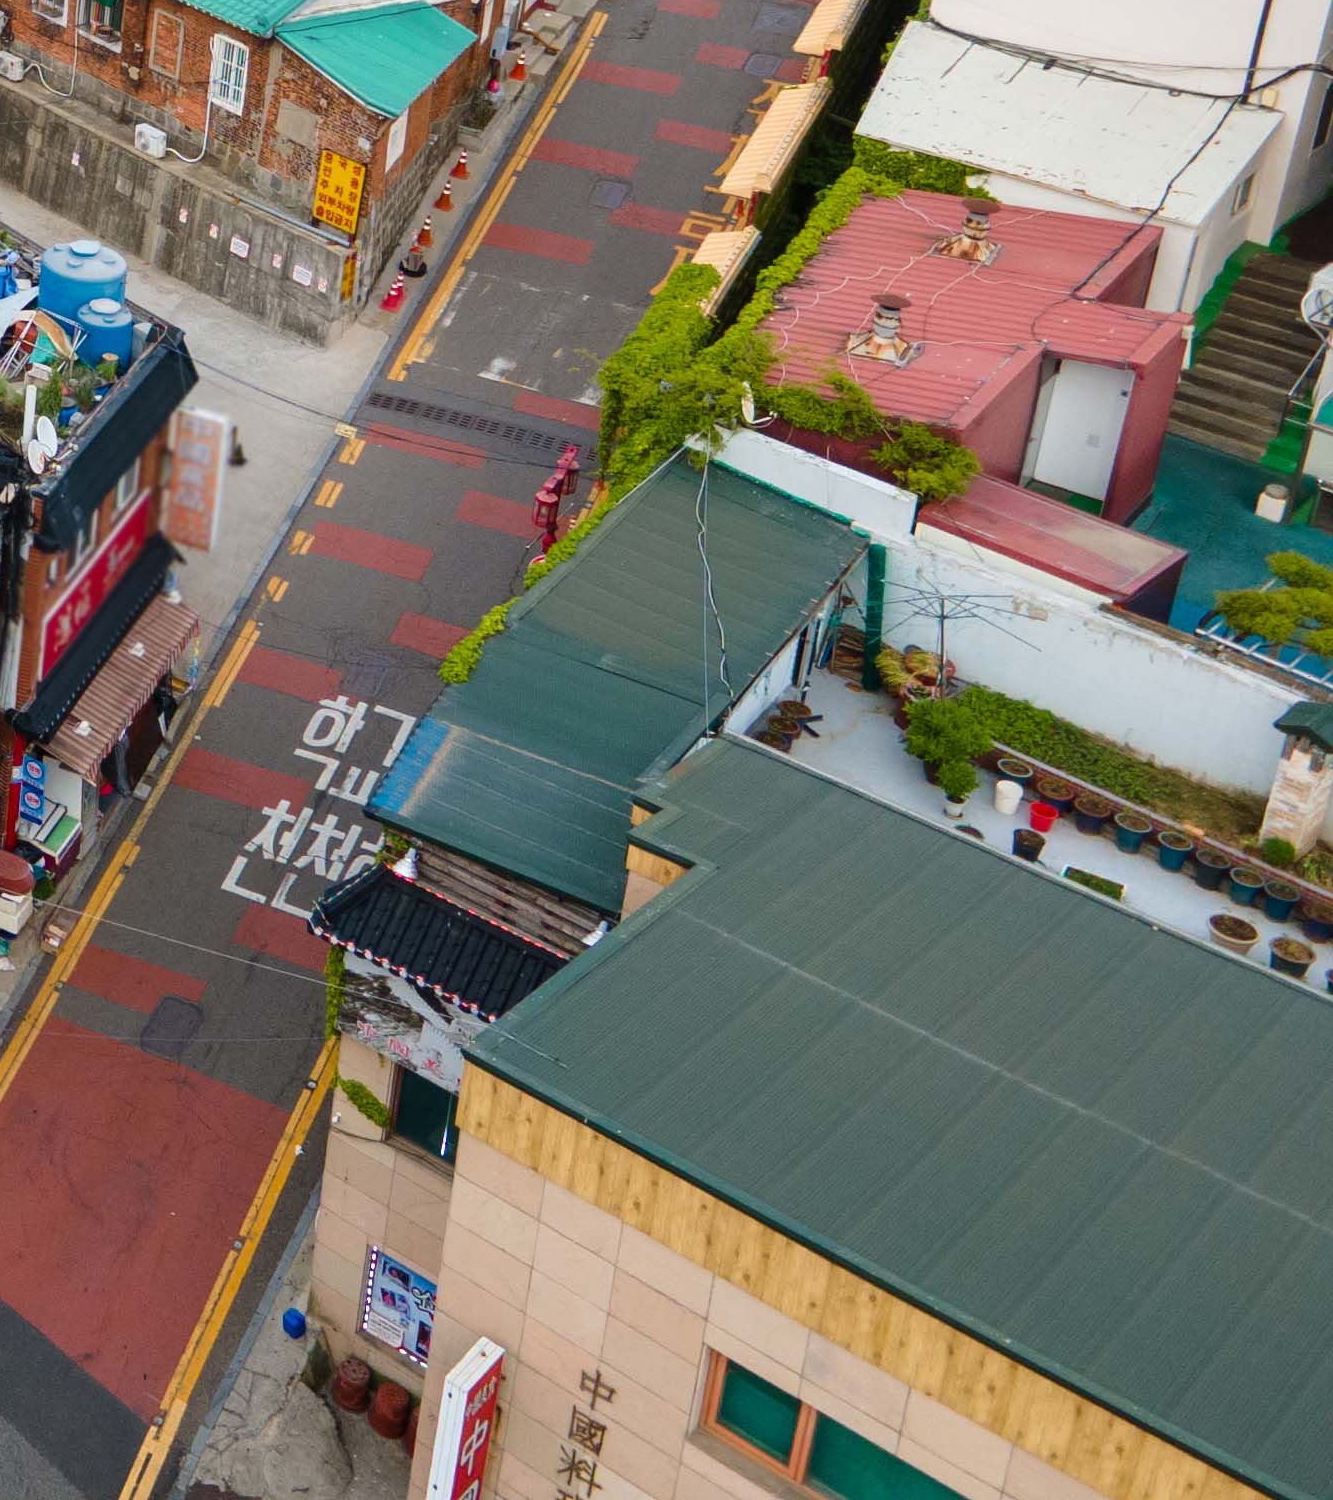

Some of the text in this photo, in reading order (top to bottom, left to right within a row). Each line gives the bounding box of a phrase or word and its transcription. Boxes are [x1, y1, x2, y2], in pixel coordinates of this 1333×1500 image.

[320, 178, 358, 203] 주차장
[318, 193, 355, 216] 외부차량
[315, 205, 353, 230] 출입금지
[293, 695, 417, 806] 학교
[555, 1369, 617, 1500] 中國料
